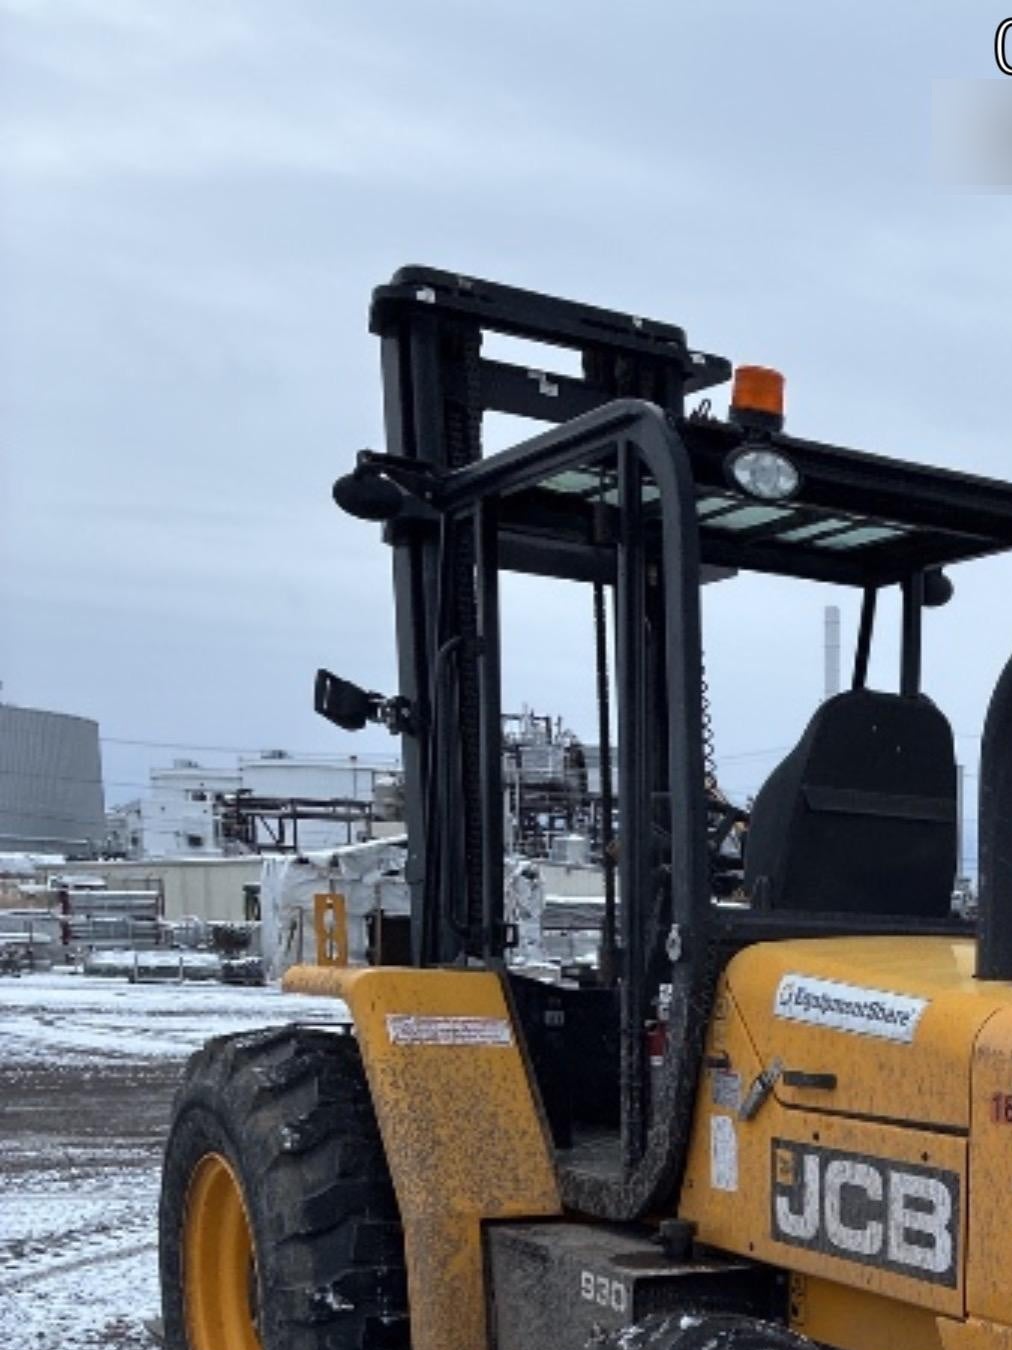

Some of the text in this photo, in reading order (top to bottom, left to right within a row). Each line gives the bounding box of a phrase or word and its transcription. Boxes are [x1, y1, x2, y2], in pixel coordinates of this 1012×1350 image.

[794, 986, 911, 1027] EquipmentShare
[776, 1153, 952, 1274] JCB
[580, 1269, 627, 1313] 930
